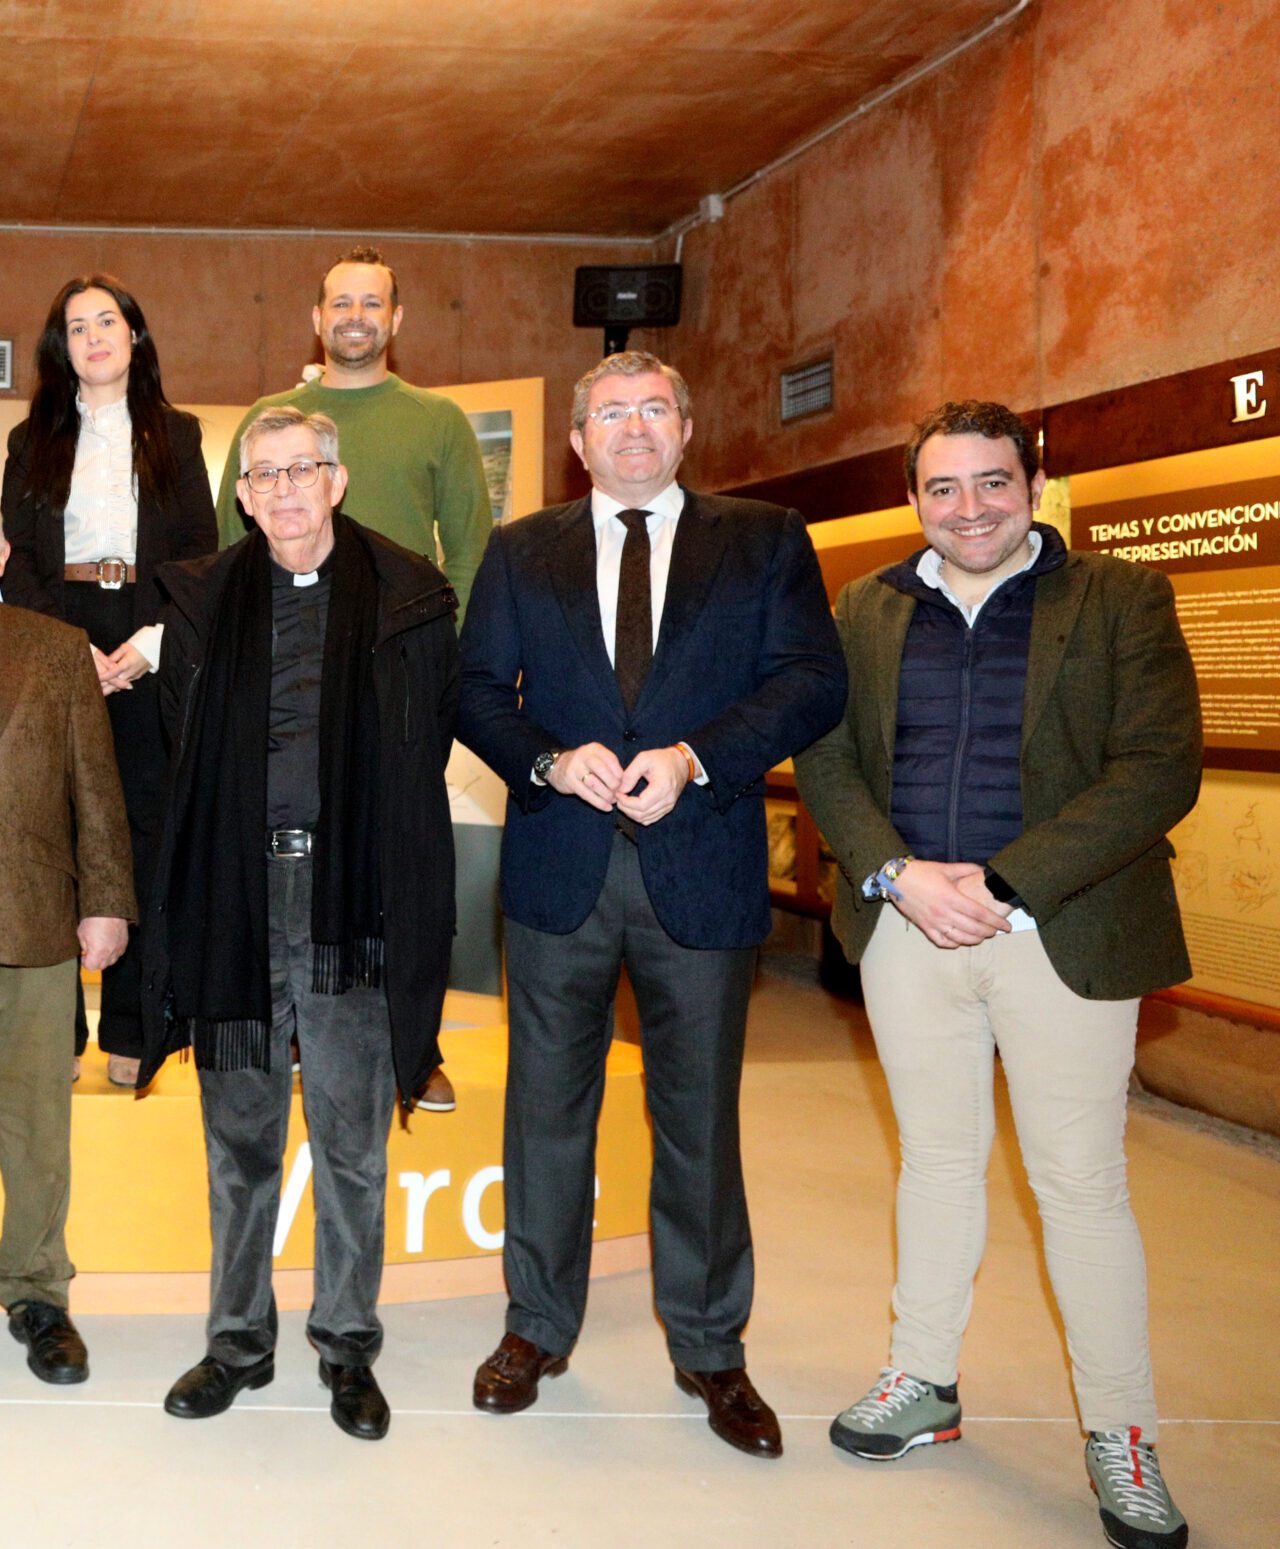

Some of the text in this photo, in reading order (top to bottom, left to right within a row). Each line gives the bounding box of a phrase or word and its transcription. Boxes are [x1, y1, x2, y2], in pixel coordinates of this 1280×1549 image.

[1229, 370, 1267, 423] E
[1089, 500, 1280, 543] TEMAS Y CONVENCION
